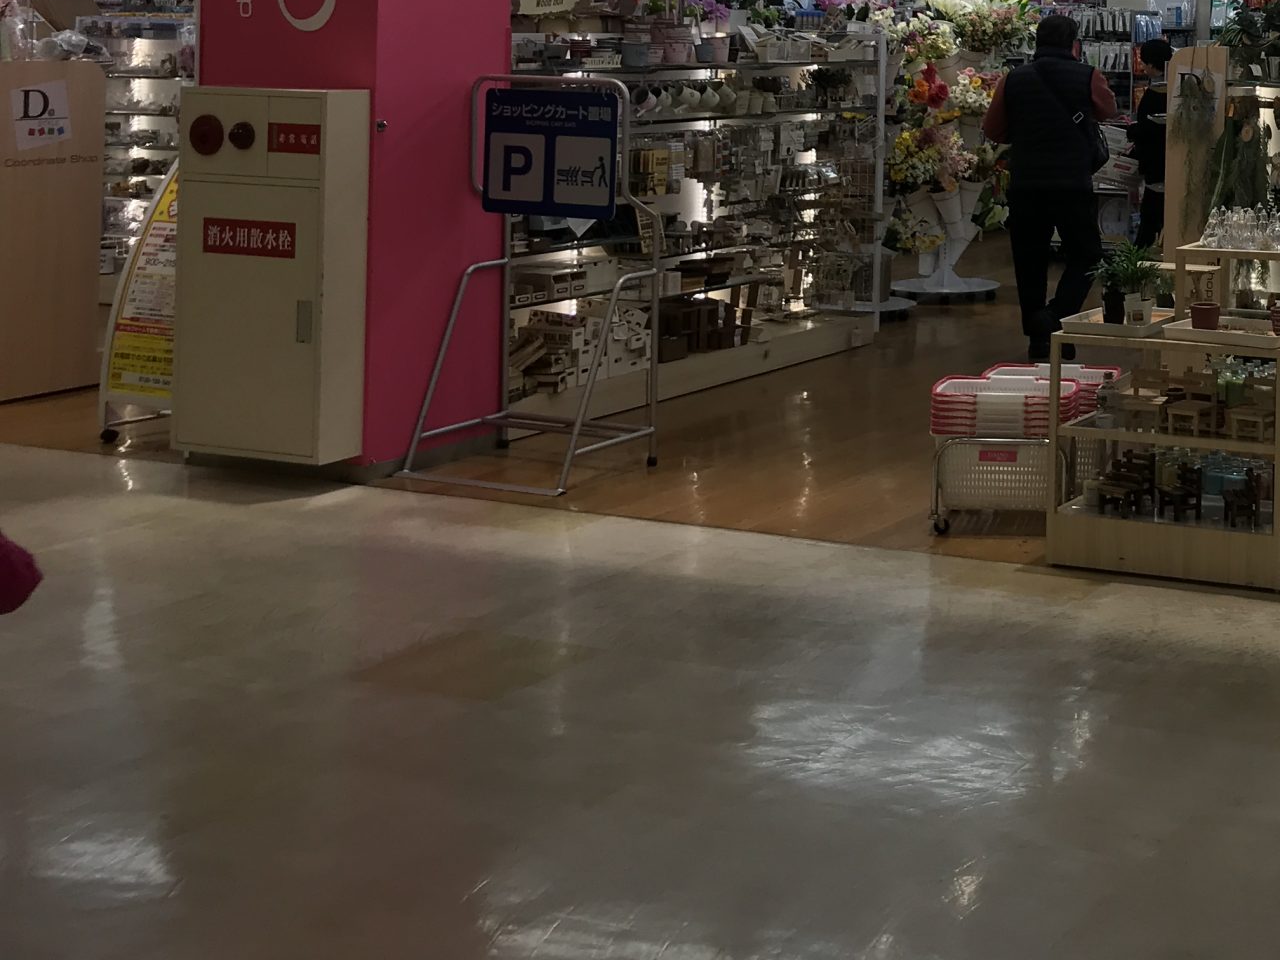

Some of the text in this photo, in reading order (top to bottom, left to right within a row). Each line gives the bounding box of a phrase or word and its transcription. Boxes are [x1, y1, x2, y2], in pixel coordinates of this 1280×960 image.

[502, 145, 533, 191] P
[207, 225, 292, 251] 消火用散水栓
